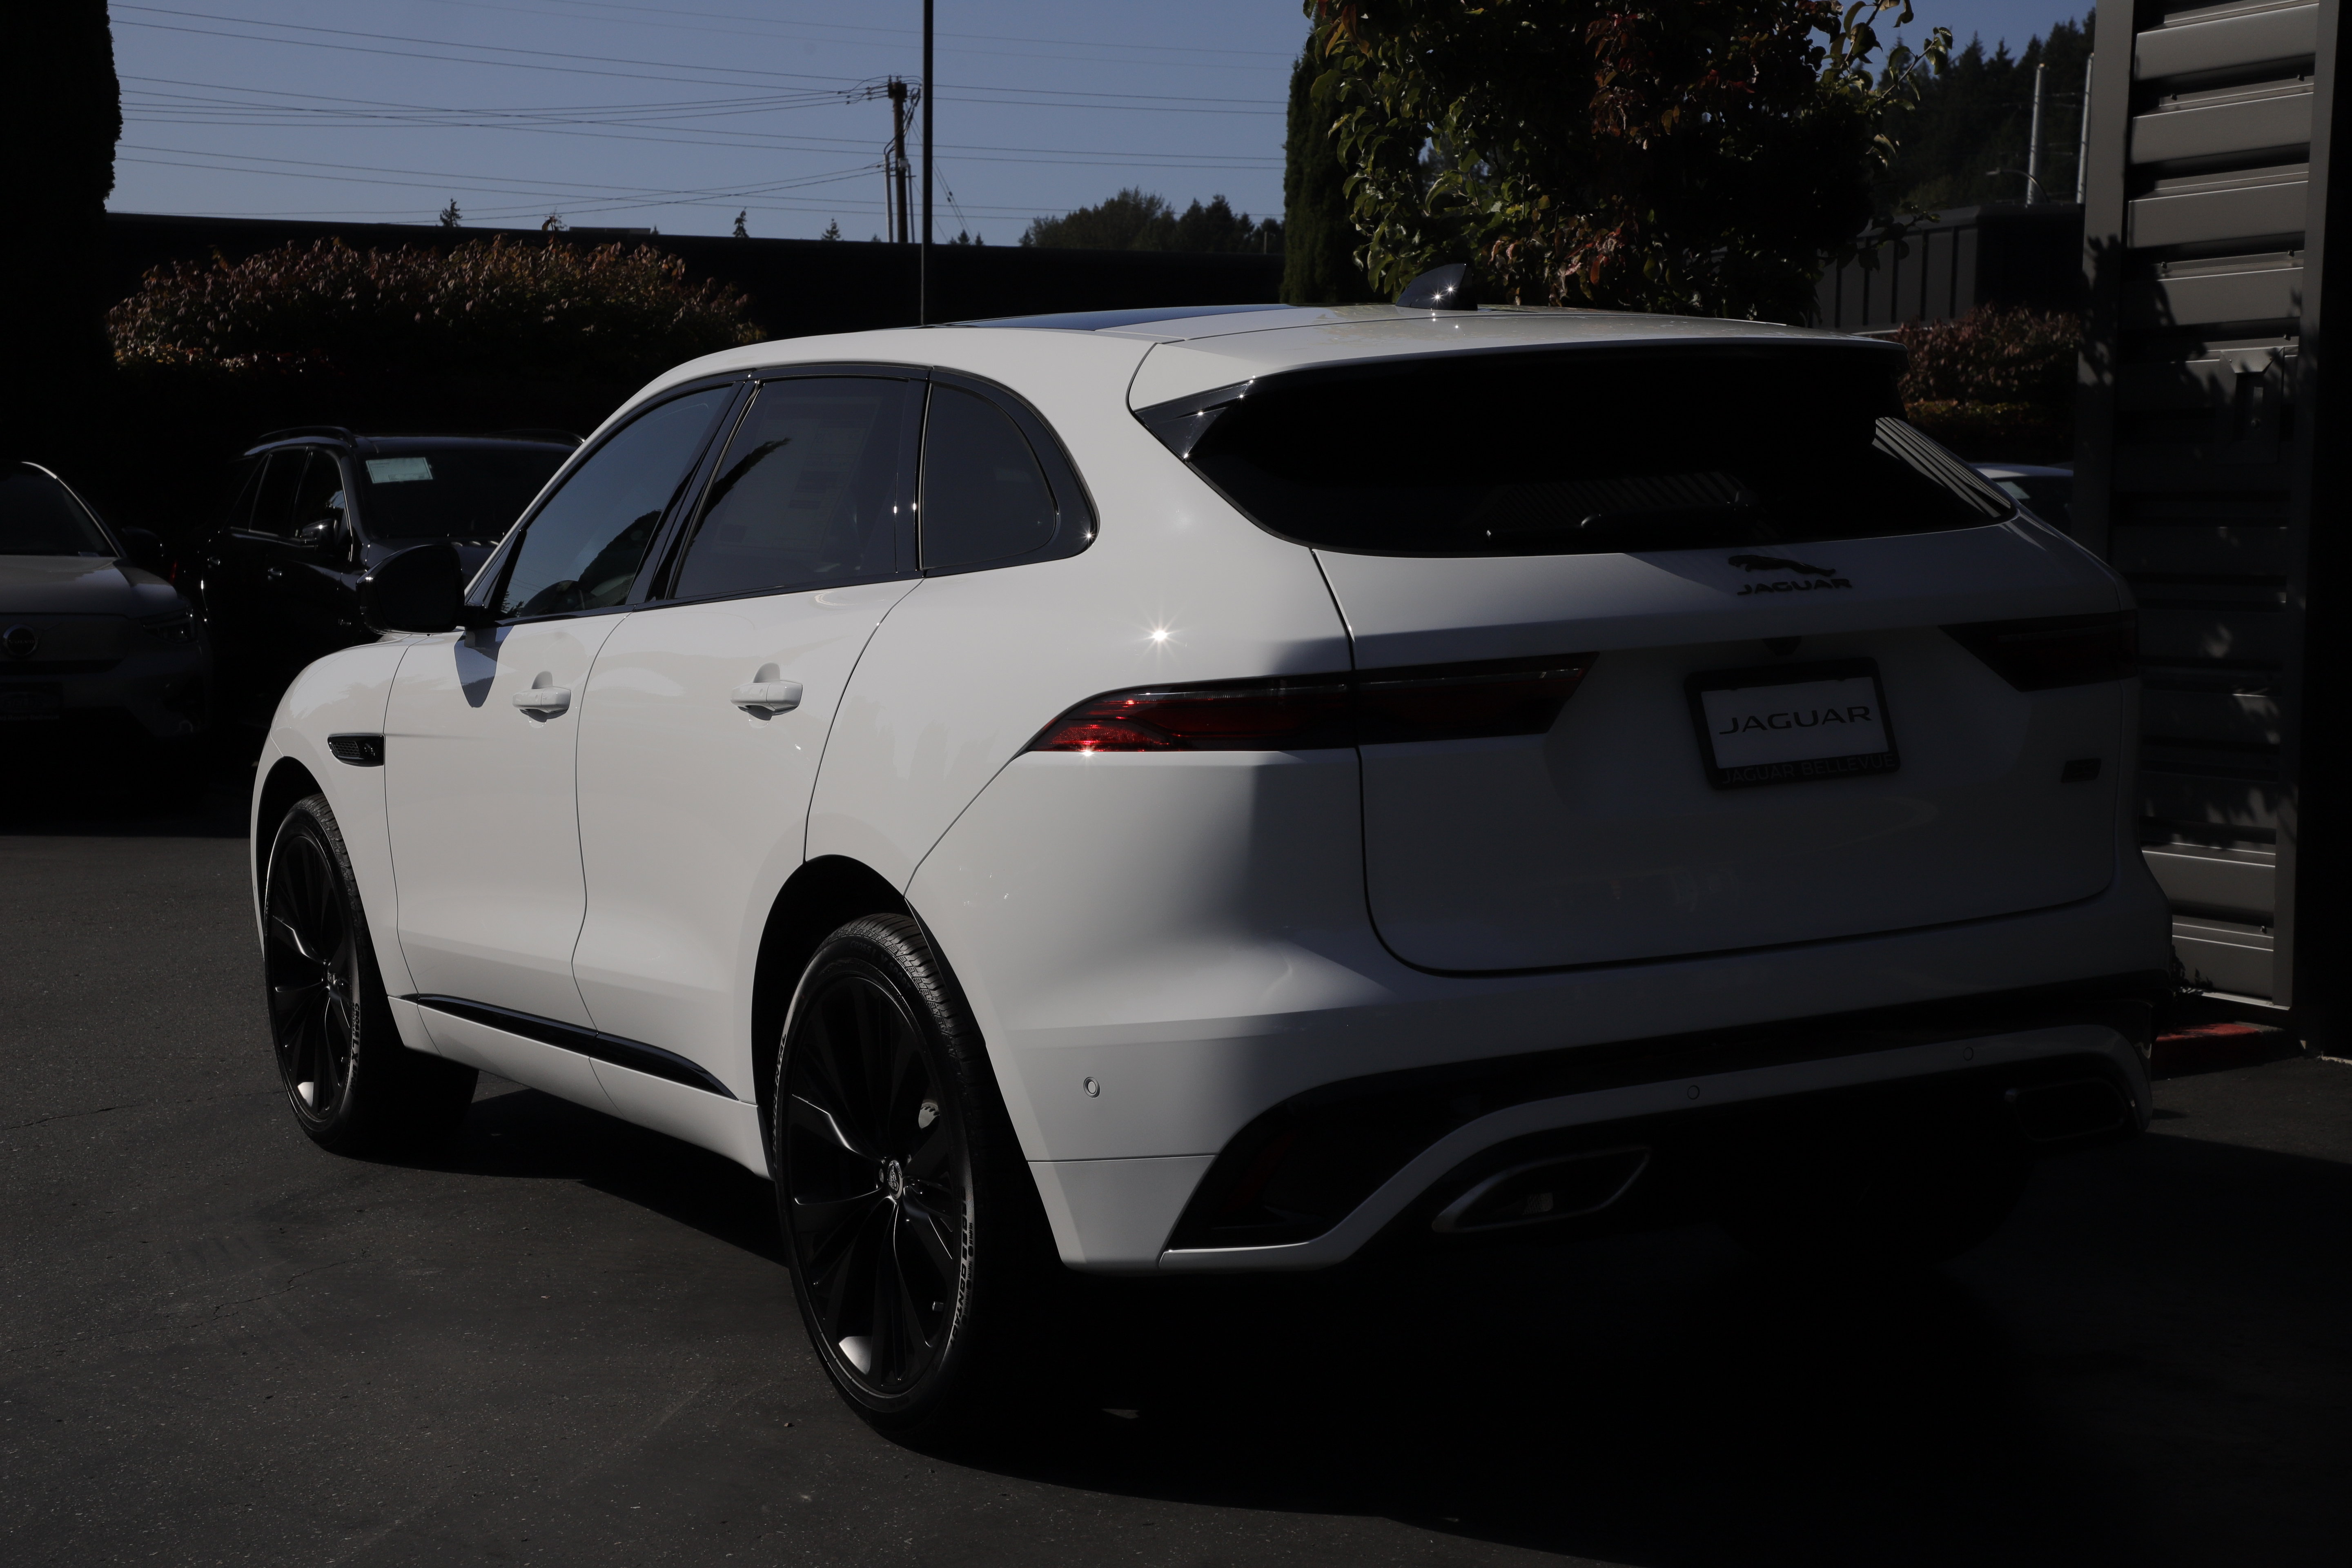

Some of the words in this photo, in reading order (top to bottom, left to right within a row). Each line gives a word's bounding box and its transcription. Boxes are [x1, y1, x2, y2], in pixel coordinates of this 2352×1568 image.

[1737, 578, 1853, 595] JAGUAR
[1719, 706, 1873, 735] JAGUAR
[1722, 764, 1795, 784] JAGUAR
[1802, 753, 1895, 774] BELLEVUE
[850, 940, 871, 953] CROSS
[888, 962, 911, 991] SPORT
[950, 1263, 967, 1348] CONTACT
